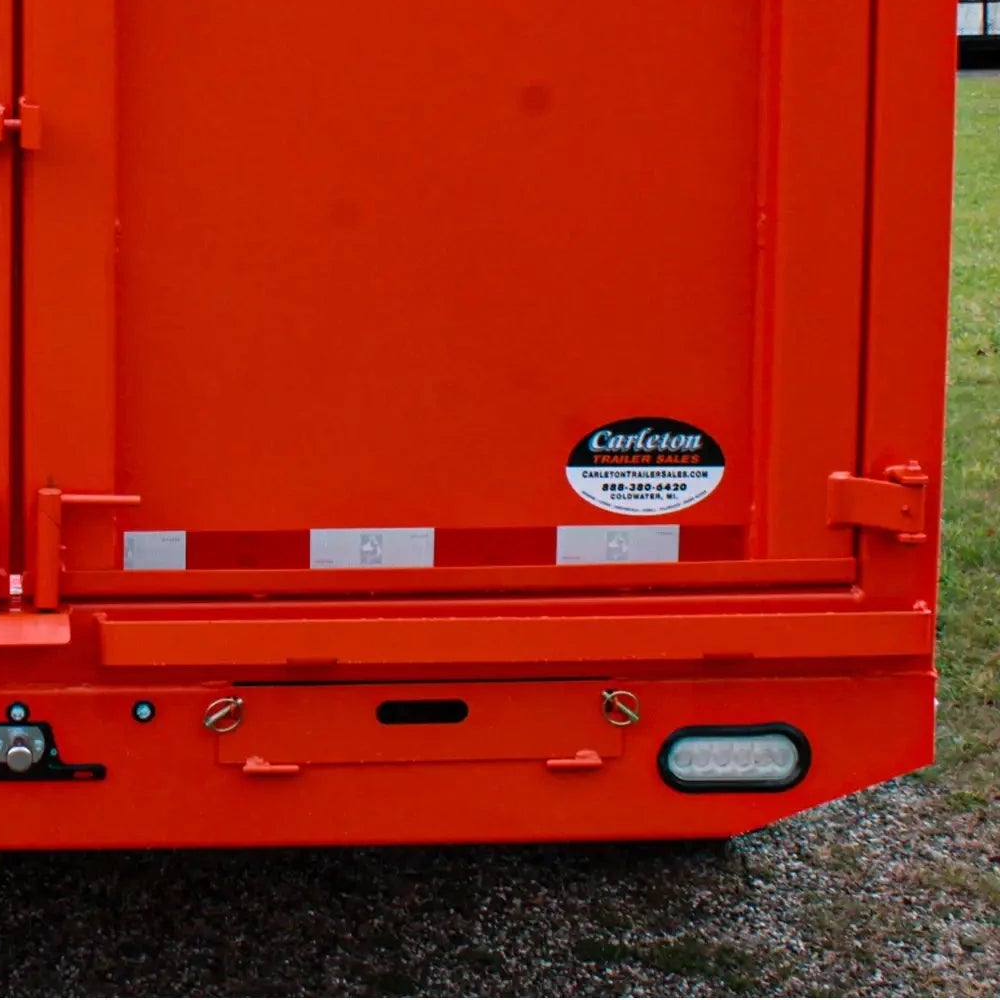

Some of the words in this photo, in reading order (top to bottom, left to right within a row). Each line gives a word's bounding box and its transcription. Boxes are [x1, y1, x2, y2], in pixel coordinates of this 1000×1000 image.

[588, 427, 703, 453] Carleton
[593, 454, 650, 464] TRAILER
[656, 454, 701, 464] SALES
[602, 483, 687, 492] 888-380-6420
